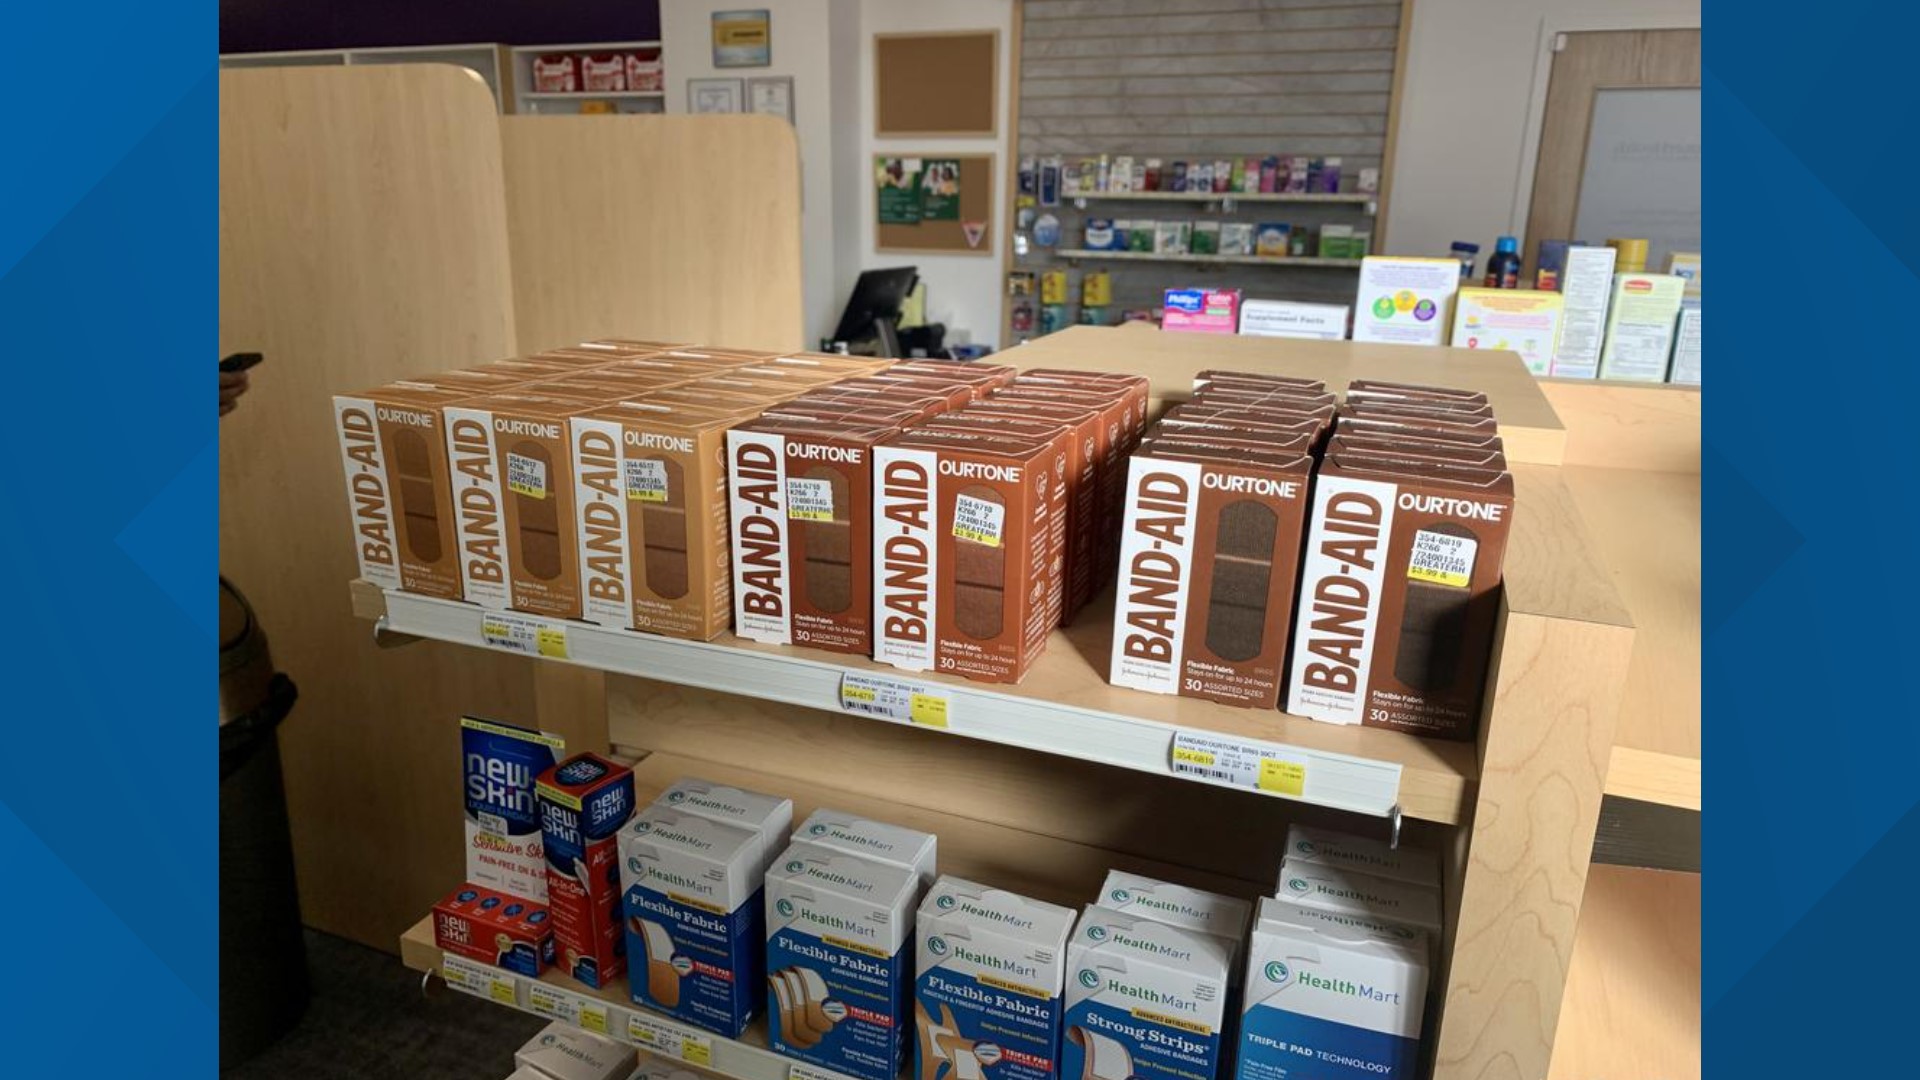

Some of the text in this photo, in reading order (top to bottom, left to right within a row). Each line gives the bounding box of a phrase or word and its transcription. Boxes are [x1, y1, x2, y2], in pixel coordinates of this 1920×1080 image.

[377, 408, 433, 428] OURTONE
[495, 419, 560, 439] OURTONE
[625, 431, 695, 453] OURTONE
[786, 442, 863, 464] OURTONE
[939, 459, 1021, 483] OURTONE
[1203, 472, 1298, 499] OURTONE
[341, 407, 393, 566] BAND-AID
[452, 419, 504, 583] BAND-AID
[579, 429, 626, 602] BAND-AID
[1398, 493, 1503, 522] OURTONE
[737, 442, 783, 618] BAND-AID
[884, 460, 929, 643] BAND-AID
[1124, 472, 1188, 664] BAND-AID
[1303, 492, 1382, 694] BAND-AID
[638, 615, 651, 626] 30
[796, 629, 810, 641] 30
[940, 656, 955, 669] 30
[1187, 660, 1235, 674] Flexible Fabric
[1185, 678, 1202, 691] 30
[1369, 709, 1389, 722] 30
[467, 753, 529, 789] new
[631, 893, 681, 920] Flexible
[683, 911, 727, 933] Fabric
[778, 936, 837, 963] Flexible
[840, 955, 889, 978] Fabric
[928, 975, 1049, 1019] Flexible Fabric
[1087, 1012, 1146, 1041] Strong
[1247, 1033, 1393, 1074] TRIPLE PAD TECHNOLOGY
